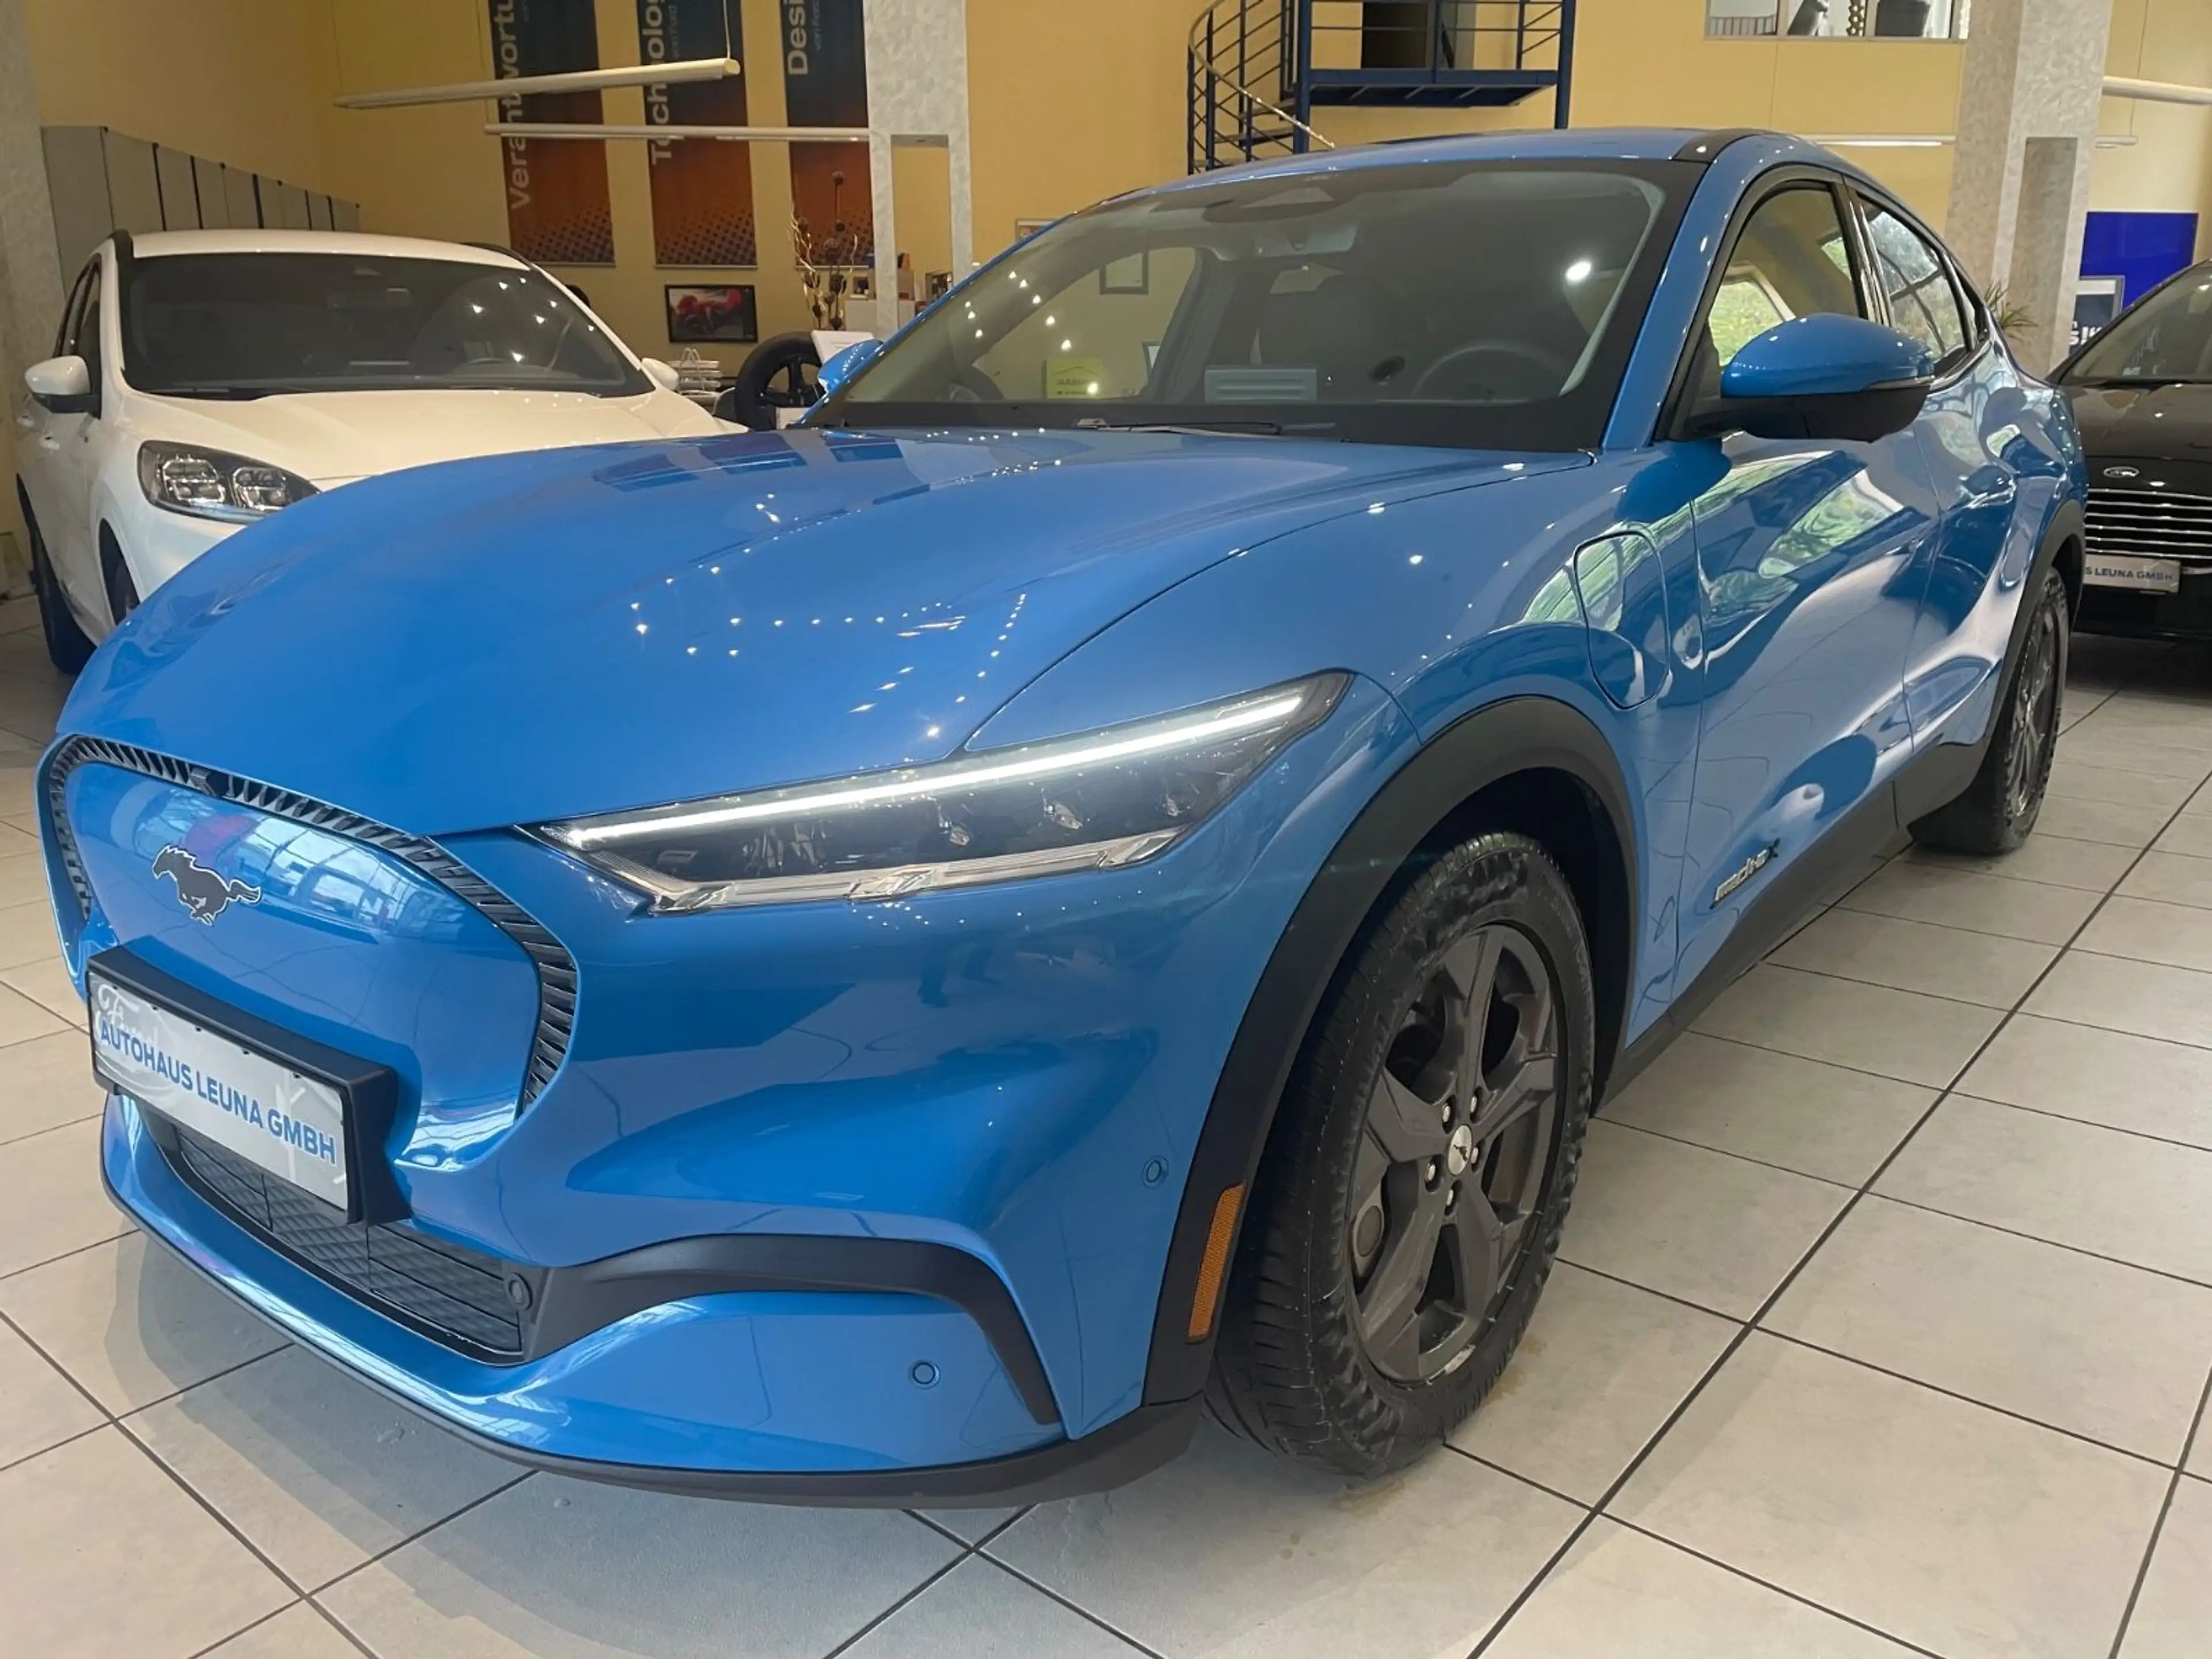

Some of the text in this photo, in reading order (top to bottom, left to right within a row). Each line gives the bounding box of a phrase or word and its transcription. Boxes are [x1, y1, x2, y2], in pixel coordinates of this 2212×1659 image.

[101, 1018, 336, 1165] AUTOHAUS LEUNA GMBH
